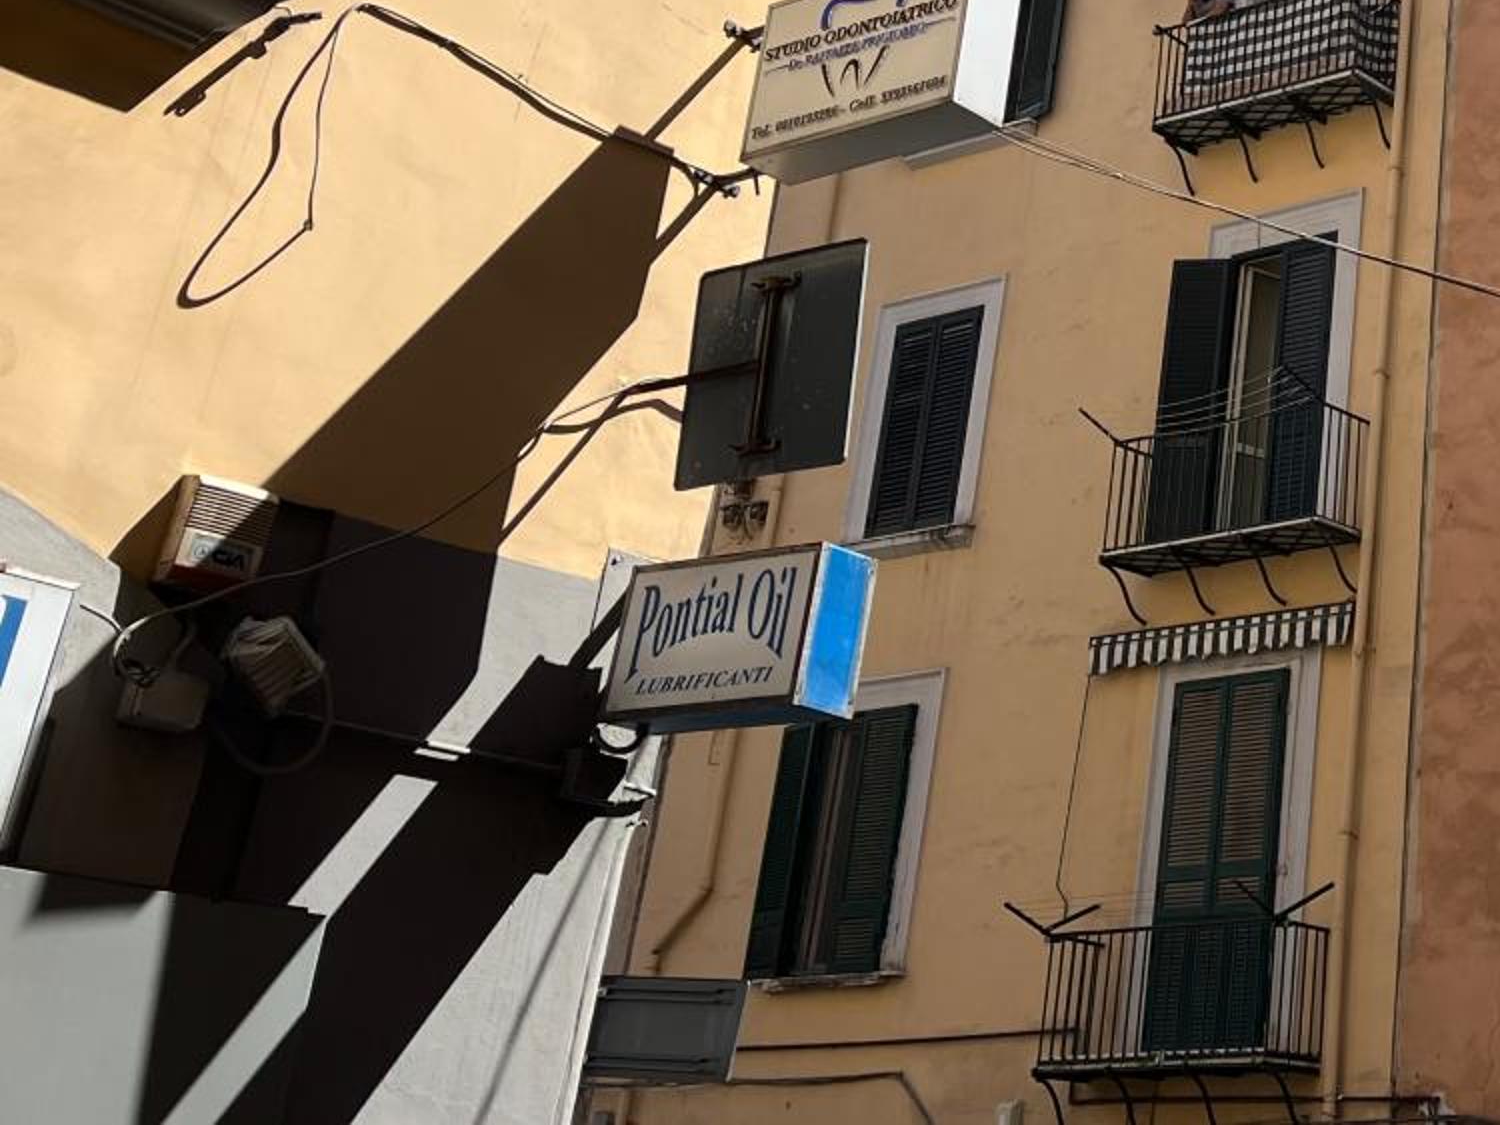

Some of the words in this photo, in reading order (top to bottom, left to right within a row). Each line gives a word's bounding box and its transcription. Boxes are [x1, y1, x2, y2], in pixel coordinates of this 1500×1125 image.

[764, 35, 820, 61] STUDIO
[625, 573, 743, 683] Pontial
[747, 567, 797, 660] Oil
[635, 665, 773, 695] LUBRIFICANTI
